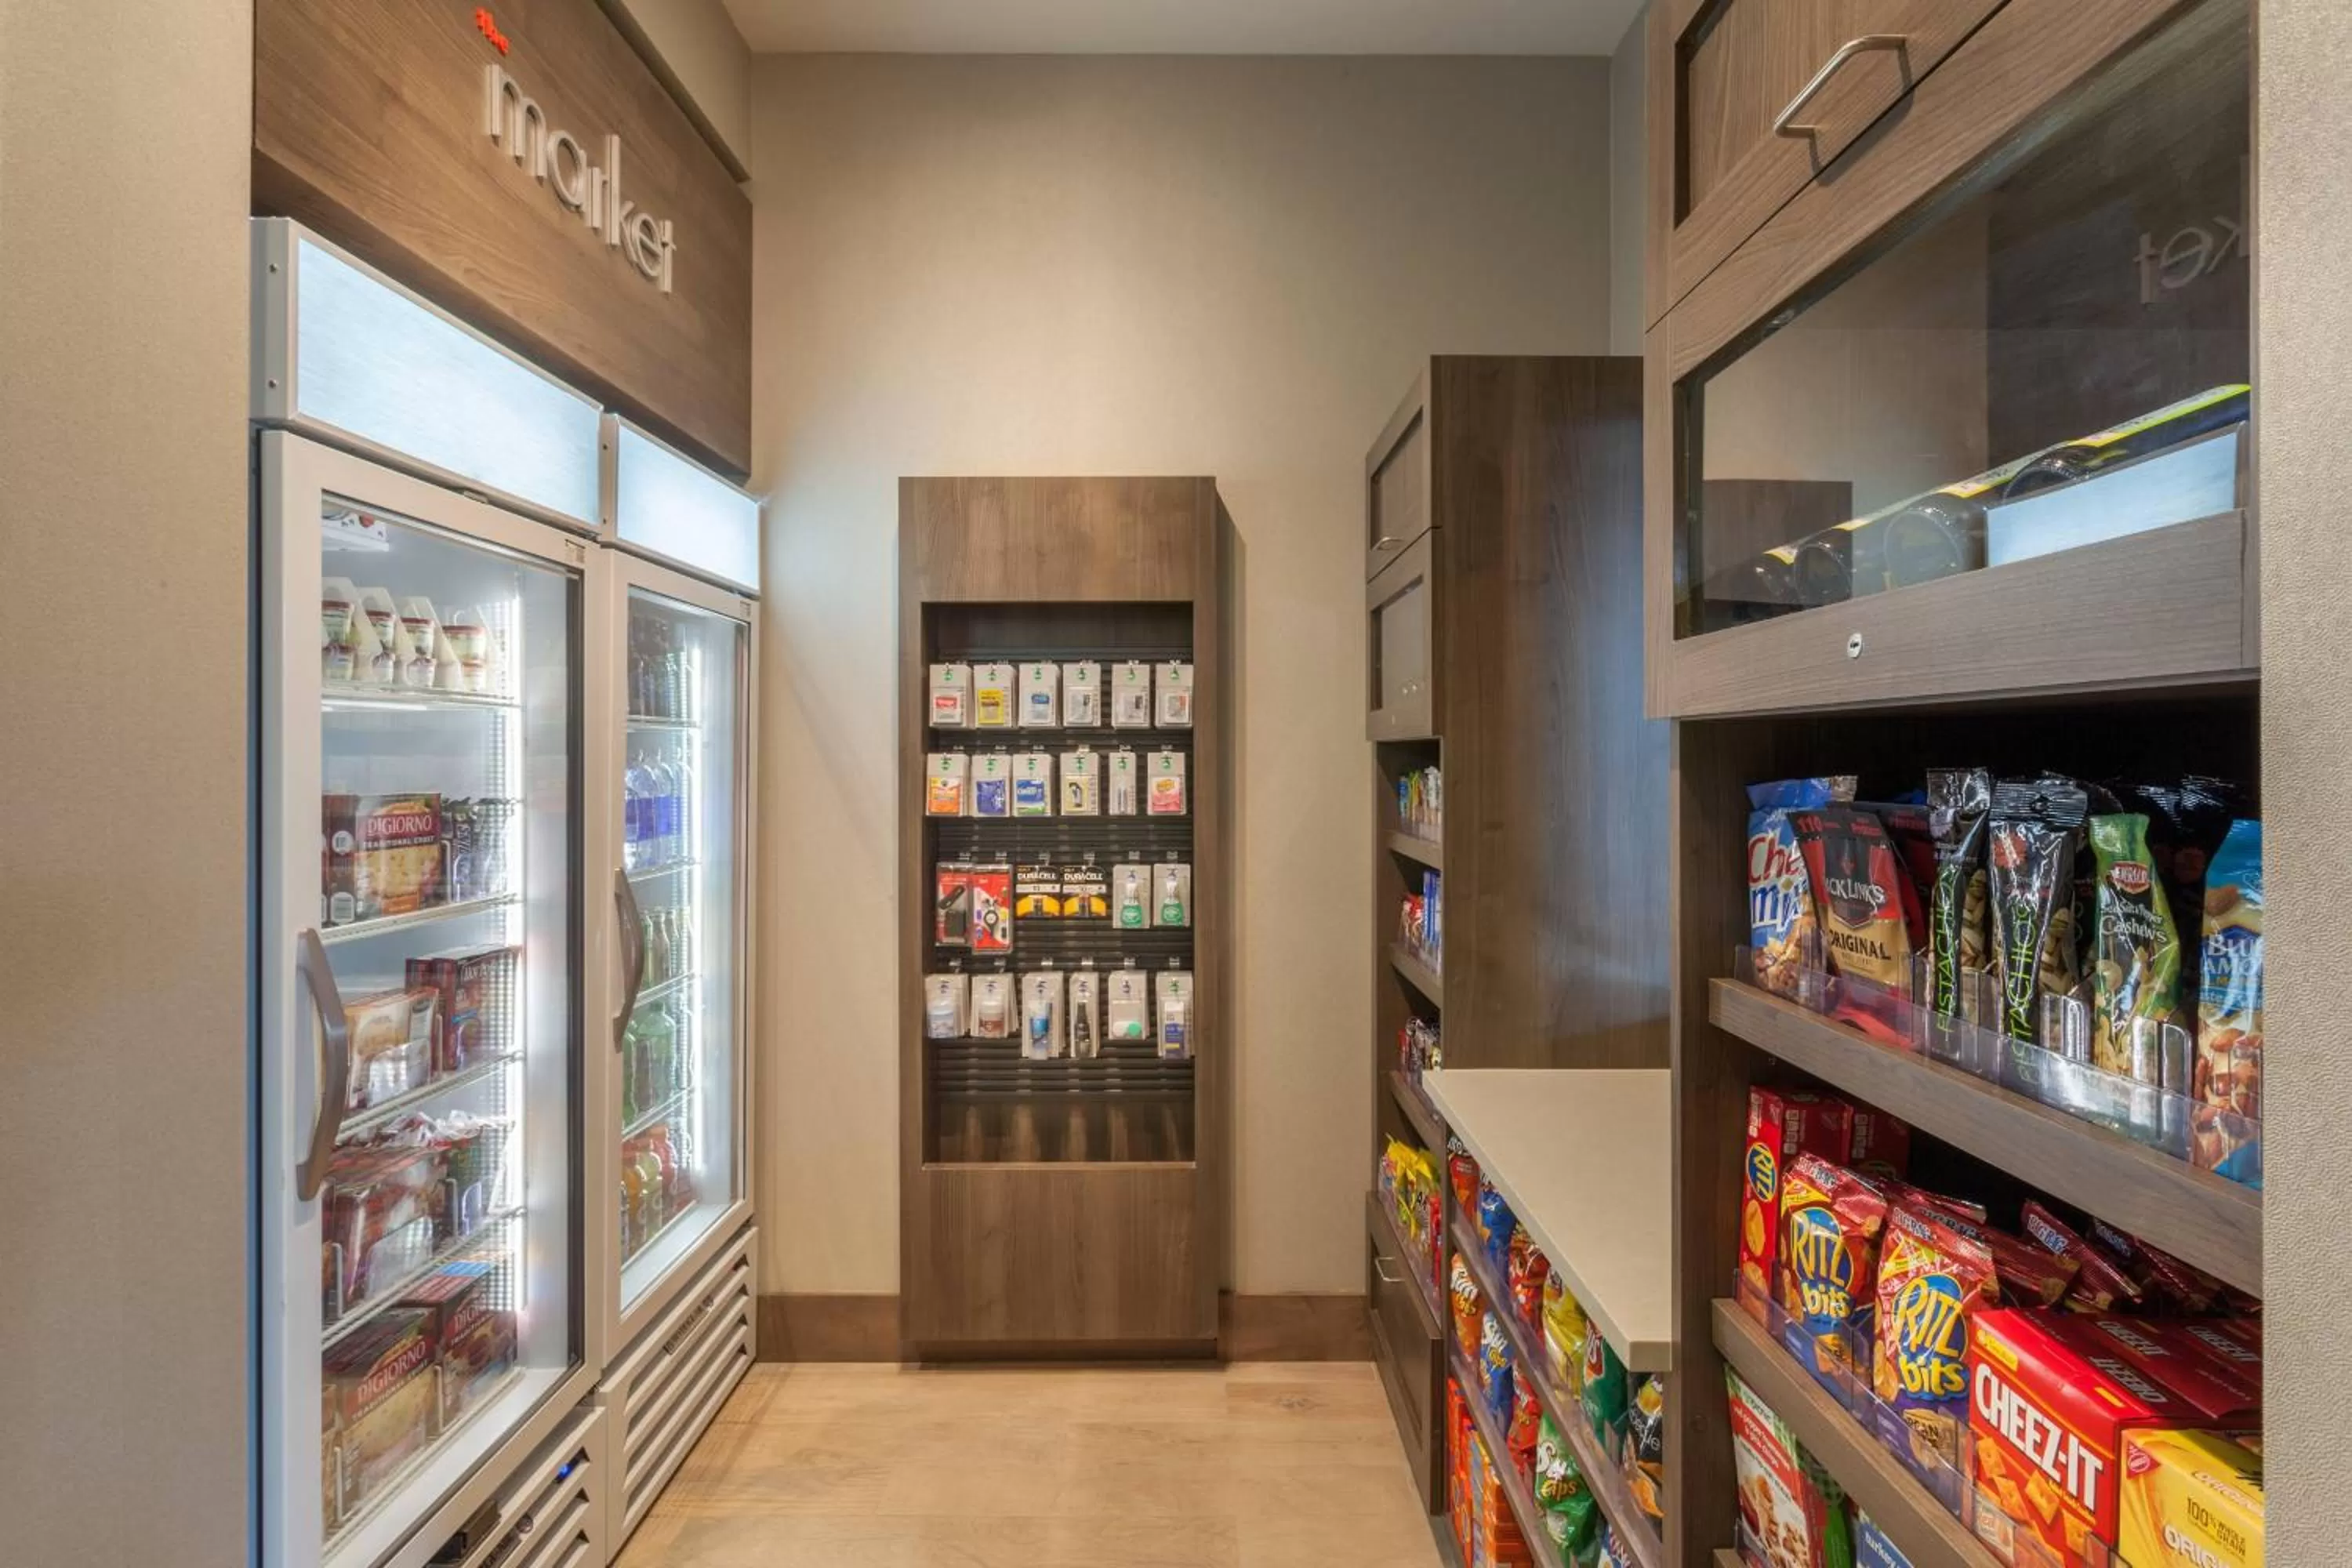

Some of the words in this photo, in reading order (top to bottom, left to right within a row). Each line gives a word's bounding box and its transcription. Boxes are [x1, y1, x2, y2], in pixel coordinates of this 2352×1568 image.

[484, 63, 677, 293] market
[367, 815, 433, 836] DIGIORNO
[2100, 915, 2168, 943] Cashews
[1791, 1212, 1846, 1287] RITZ
[1801, 1282, 1851, 1317] bits
[1893, 1275, 1962, 1357] RITZ
[357, 1340, 427, 1406] DIGIORNO
[1898, 1354, 1963, 1396] bits
[1975, 1363, 2104, 1513] CHEEZ-IT
